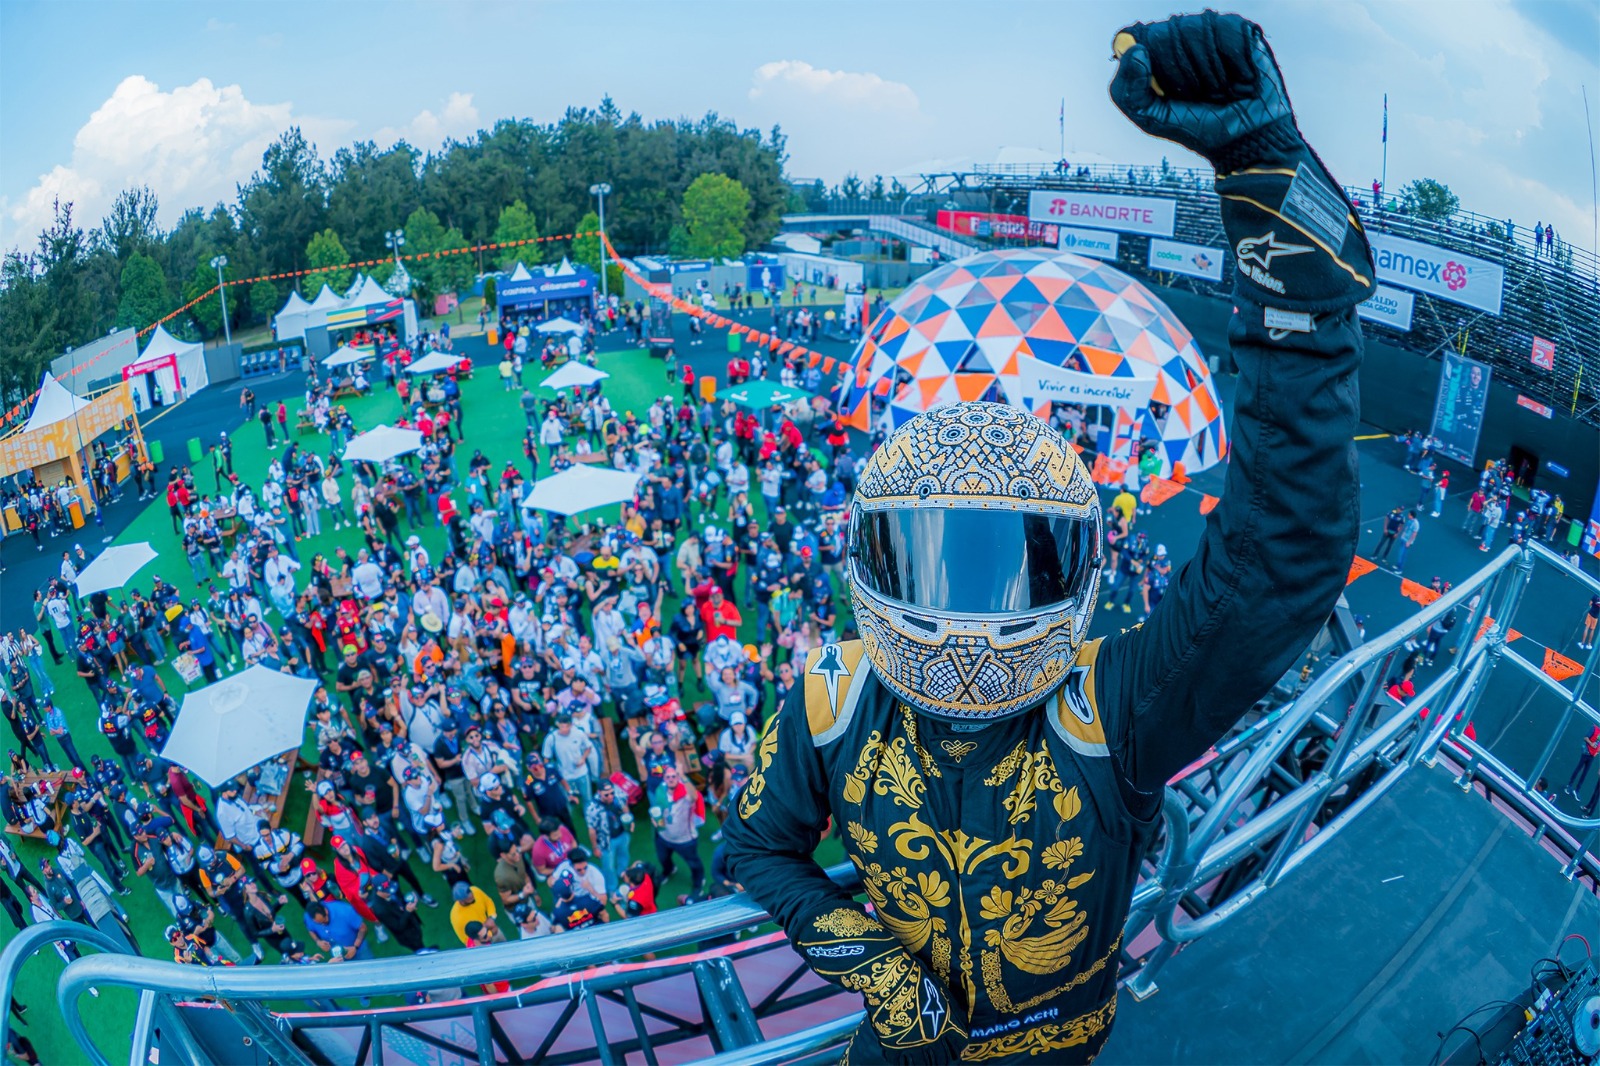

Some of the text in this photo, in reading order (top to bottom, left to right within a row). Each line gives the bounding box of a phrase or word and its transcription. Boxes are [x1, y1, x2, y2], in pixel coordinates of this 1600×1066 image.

[1070, 203, 1153, 223] BANORTE
[1156, 250, 1182, 261] codere
[1375, 303, 1397, 315] GROUP
[1534, 349, 1550, 367] 2A
[1039, 379, 1066, 391] Vivir
[1070, 386, 1080, 394] es
[971, 1007, 1059, 1038] MARIO ACHI
